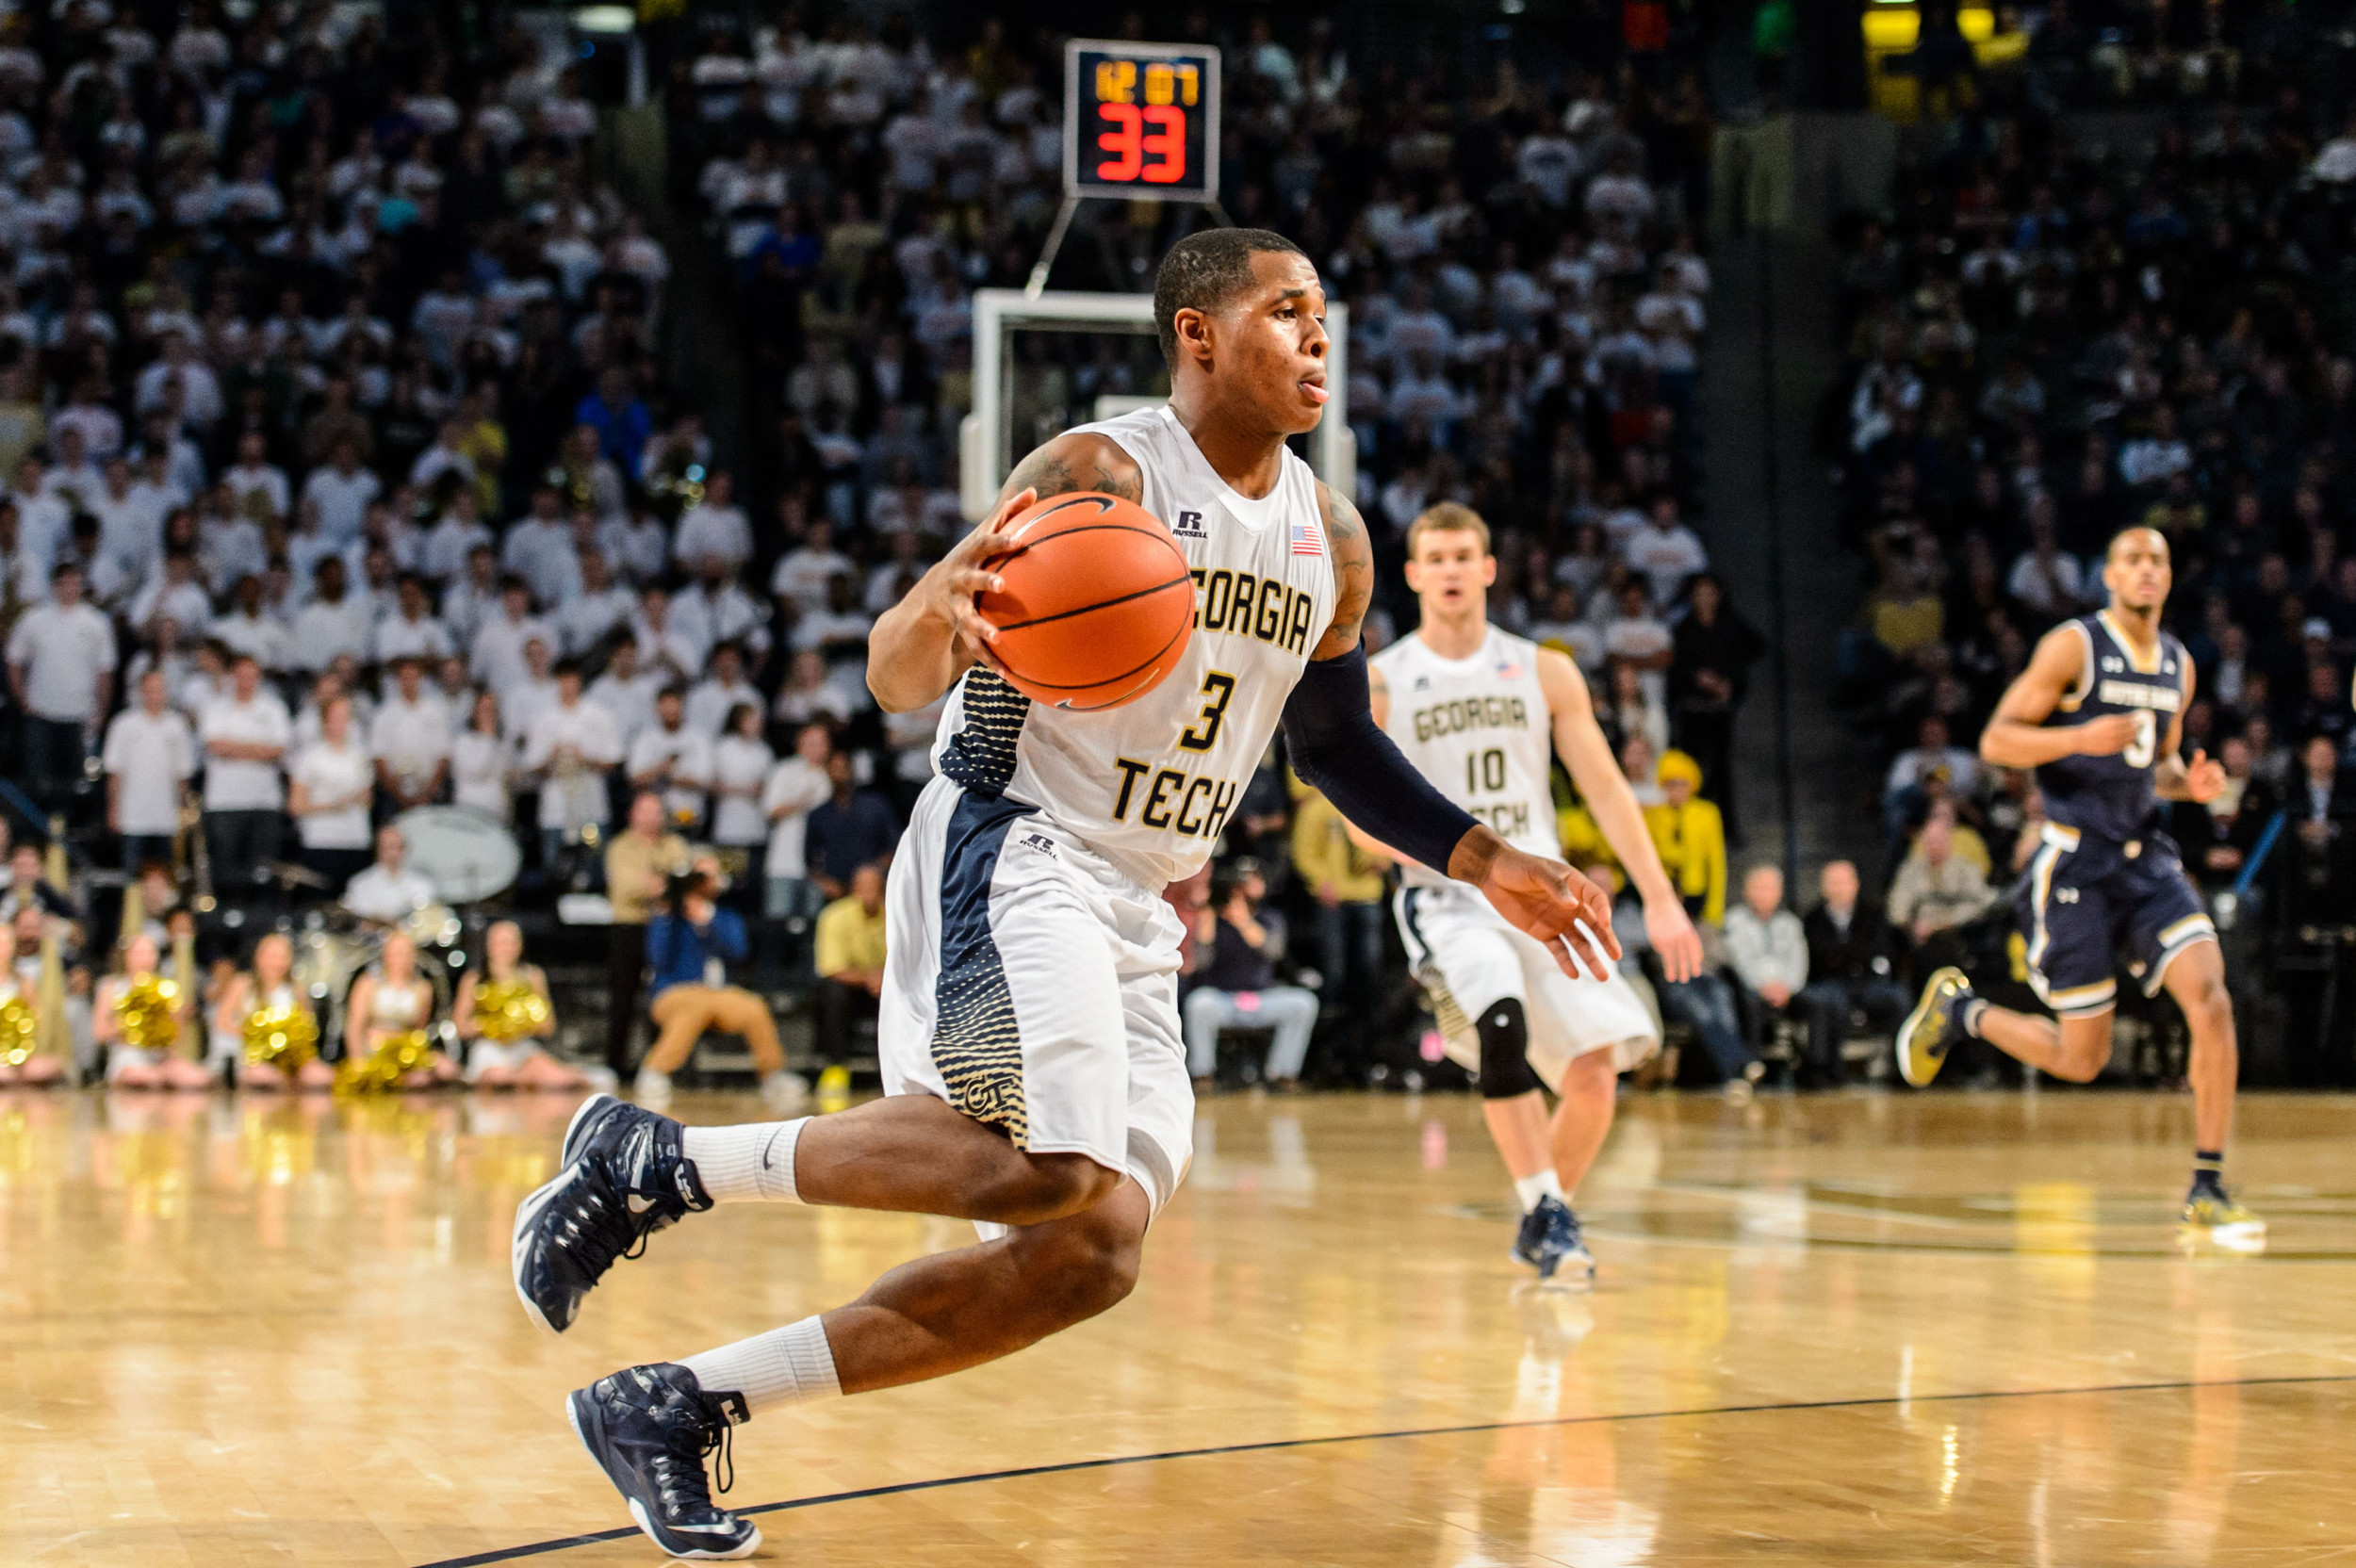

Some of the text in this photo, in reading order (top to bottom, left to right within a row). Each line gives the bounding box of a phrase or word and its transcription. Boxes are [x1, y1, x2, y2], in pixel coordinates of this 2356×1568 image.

[1097, 103, 1186, 183] 33
[1171, 529, 1208, 539] RUSSELL
[1189, 567, 1312, 657] ORGIA
[1179, 669, 1237, 754] 3
[1414, 695, 1529, 743] GEORGIA
[1112, 757, 1237, 841] TECH
[1466, 747, 1505, 795] 10
